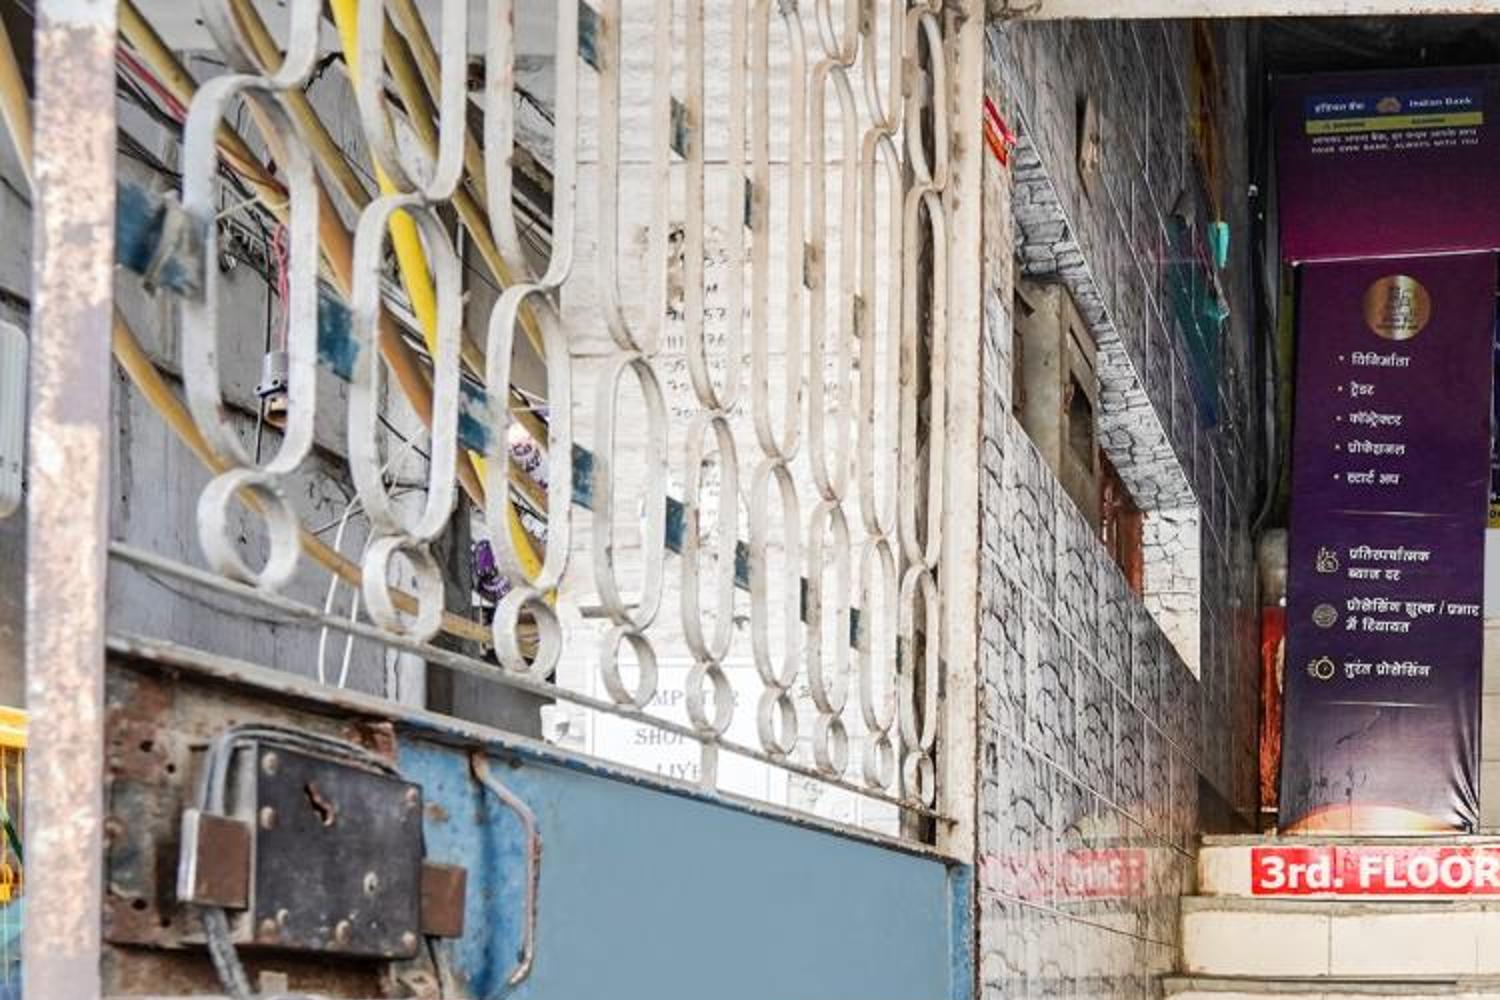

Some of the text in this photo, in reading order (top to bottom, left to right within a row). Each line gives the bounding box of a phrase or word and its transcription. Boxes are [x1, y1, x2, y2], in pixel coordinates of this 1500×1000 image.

[1348, 567, 1401, 580] ब्याज दर
[1347, 596, 1402, 613] प्रोसेसिंग
[1405, 602, 1437, 618] शुल्क
[1345, 616, 1358, 630] में
[1344, 659, 1432, 679] तुरंत प्रोसेसिंग
[1260, 855, 1343, 889] 3rd.
